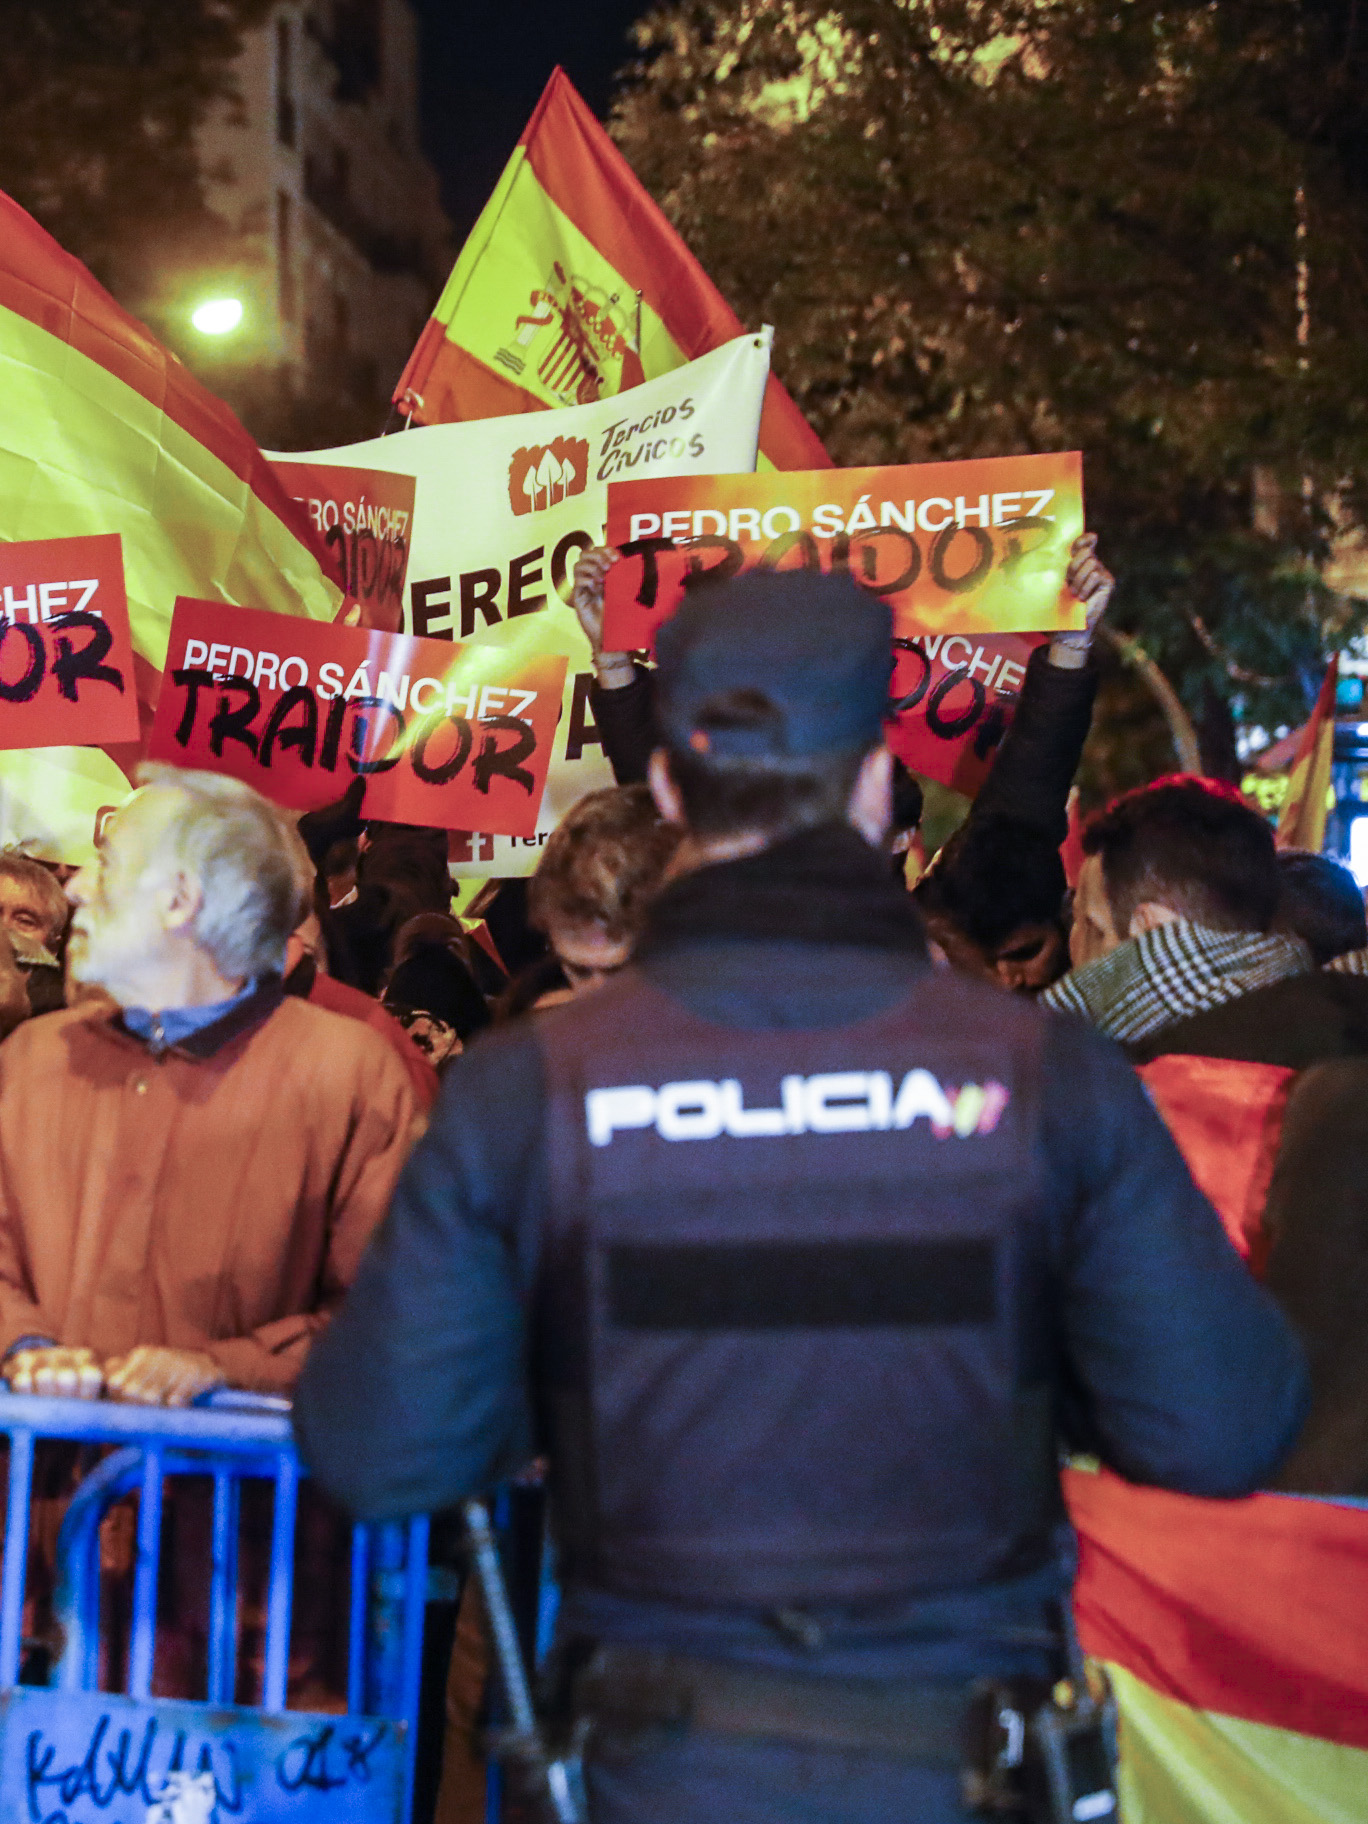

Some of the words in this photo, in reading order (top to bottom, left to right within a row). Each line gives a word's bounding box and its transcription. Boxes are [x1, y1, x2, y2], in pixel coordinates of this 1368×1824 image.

[630, 506, 801, 544] PEDRO
[811, 489, 1055, 540] SÁNCHEZ
[183, 638, 309, 692] PEDRO
[316, 660, 537, 725] SÁNCHEZ
[172, 669, 537, 796] TRAIDOR
[585, 1068, 956, 1148] POLICIA
